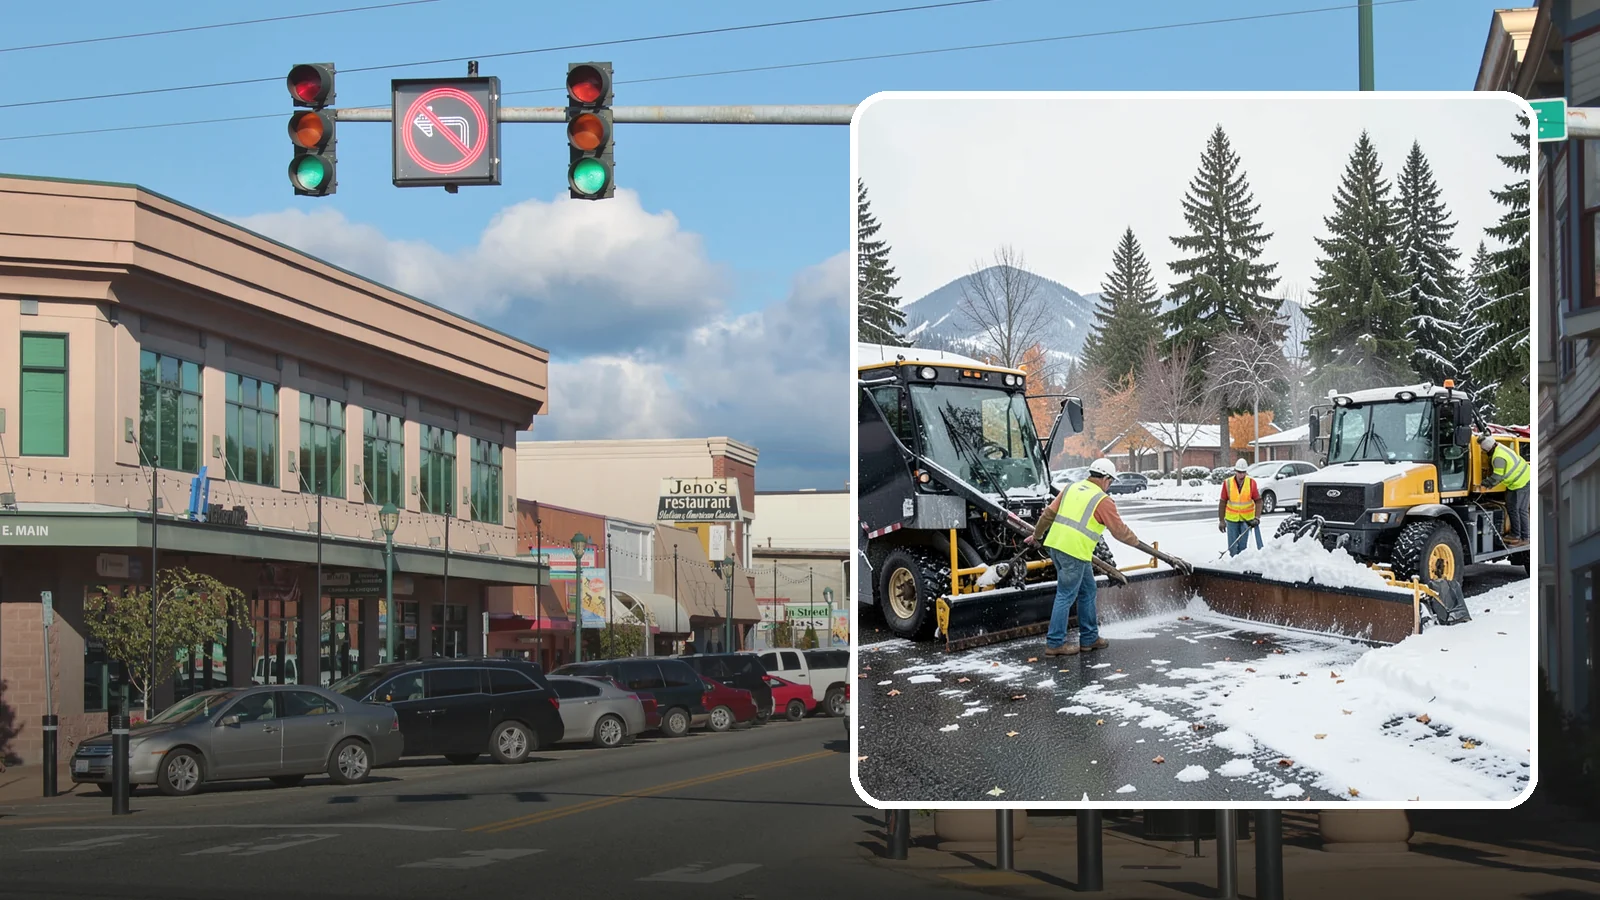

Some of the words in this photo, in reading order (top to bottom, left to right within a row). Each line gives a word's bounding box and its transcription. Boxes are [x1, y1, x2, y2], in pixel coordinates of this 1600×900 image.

[669, 480, 728, 495] Jeno's
[665, 496, 731, 509] restaurant
[658, 510, 682, 520] Italian
[686, 510, 714, 520] American
[715, 510, 737, 519] Cuisine
[2, 525, 13, 536] E.
[15, 525, 49, 536] MAIN
[797, 607, 829, 617] Street
